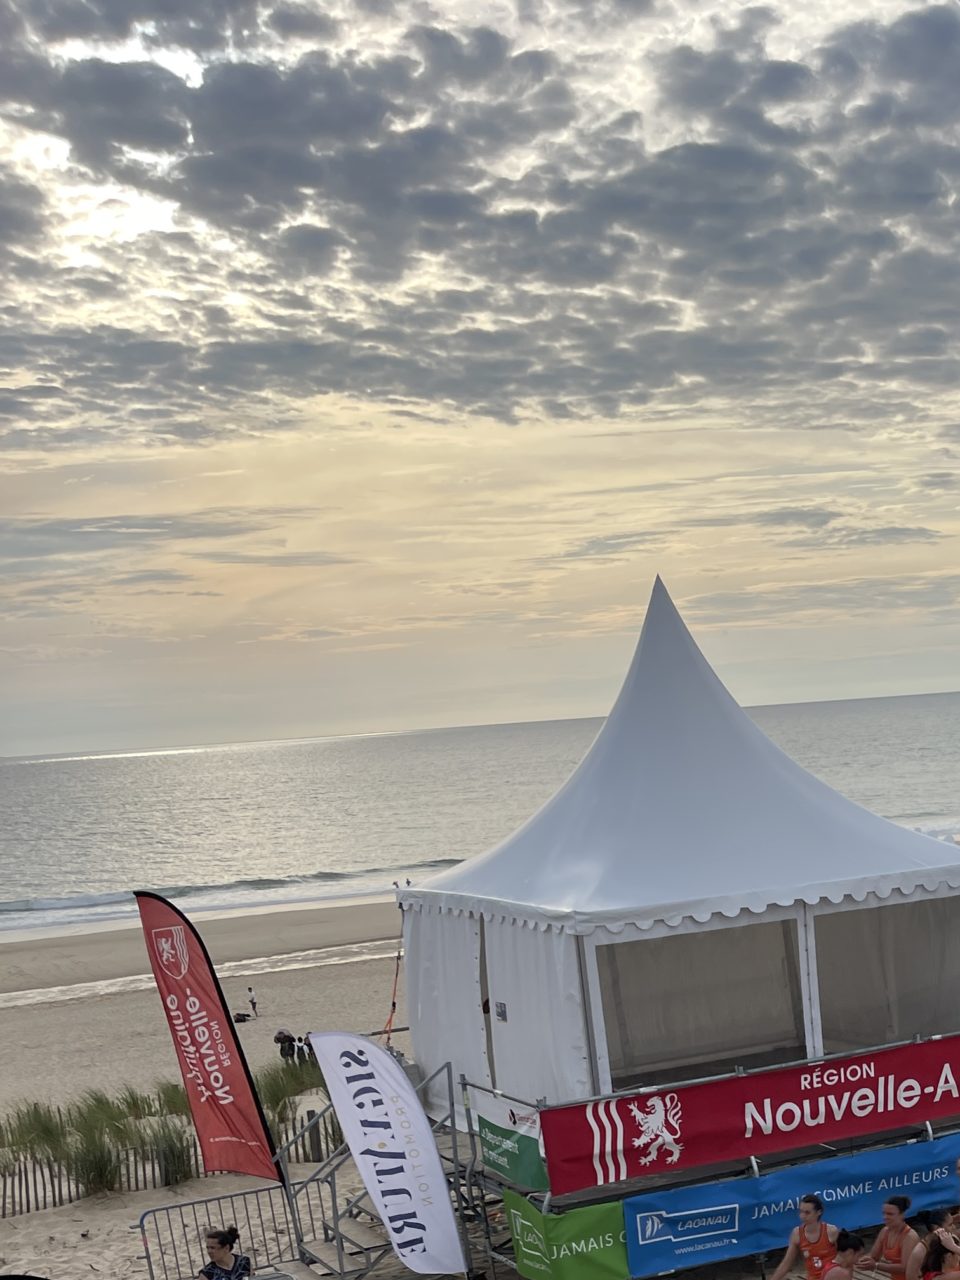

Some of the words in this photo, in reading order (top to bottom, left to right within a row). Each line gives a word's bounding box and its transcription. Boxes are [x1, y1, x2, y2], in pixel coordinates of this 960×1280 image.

[801, 1062, 875, 1090] RÉGION
[752, 1195, 806, 1219] JAMAI
[878, 1166, 949, 1191] AILLEURS
[678, 1215, 730, 1231] LACANAU
[551, 1233, 614, 1259] JAMAIS
